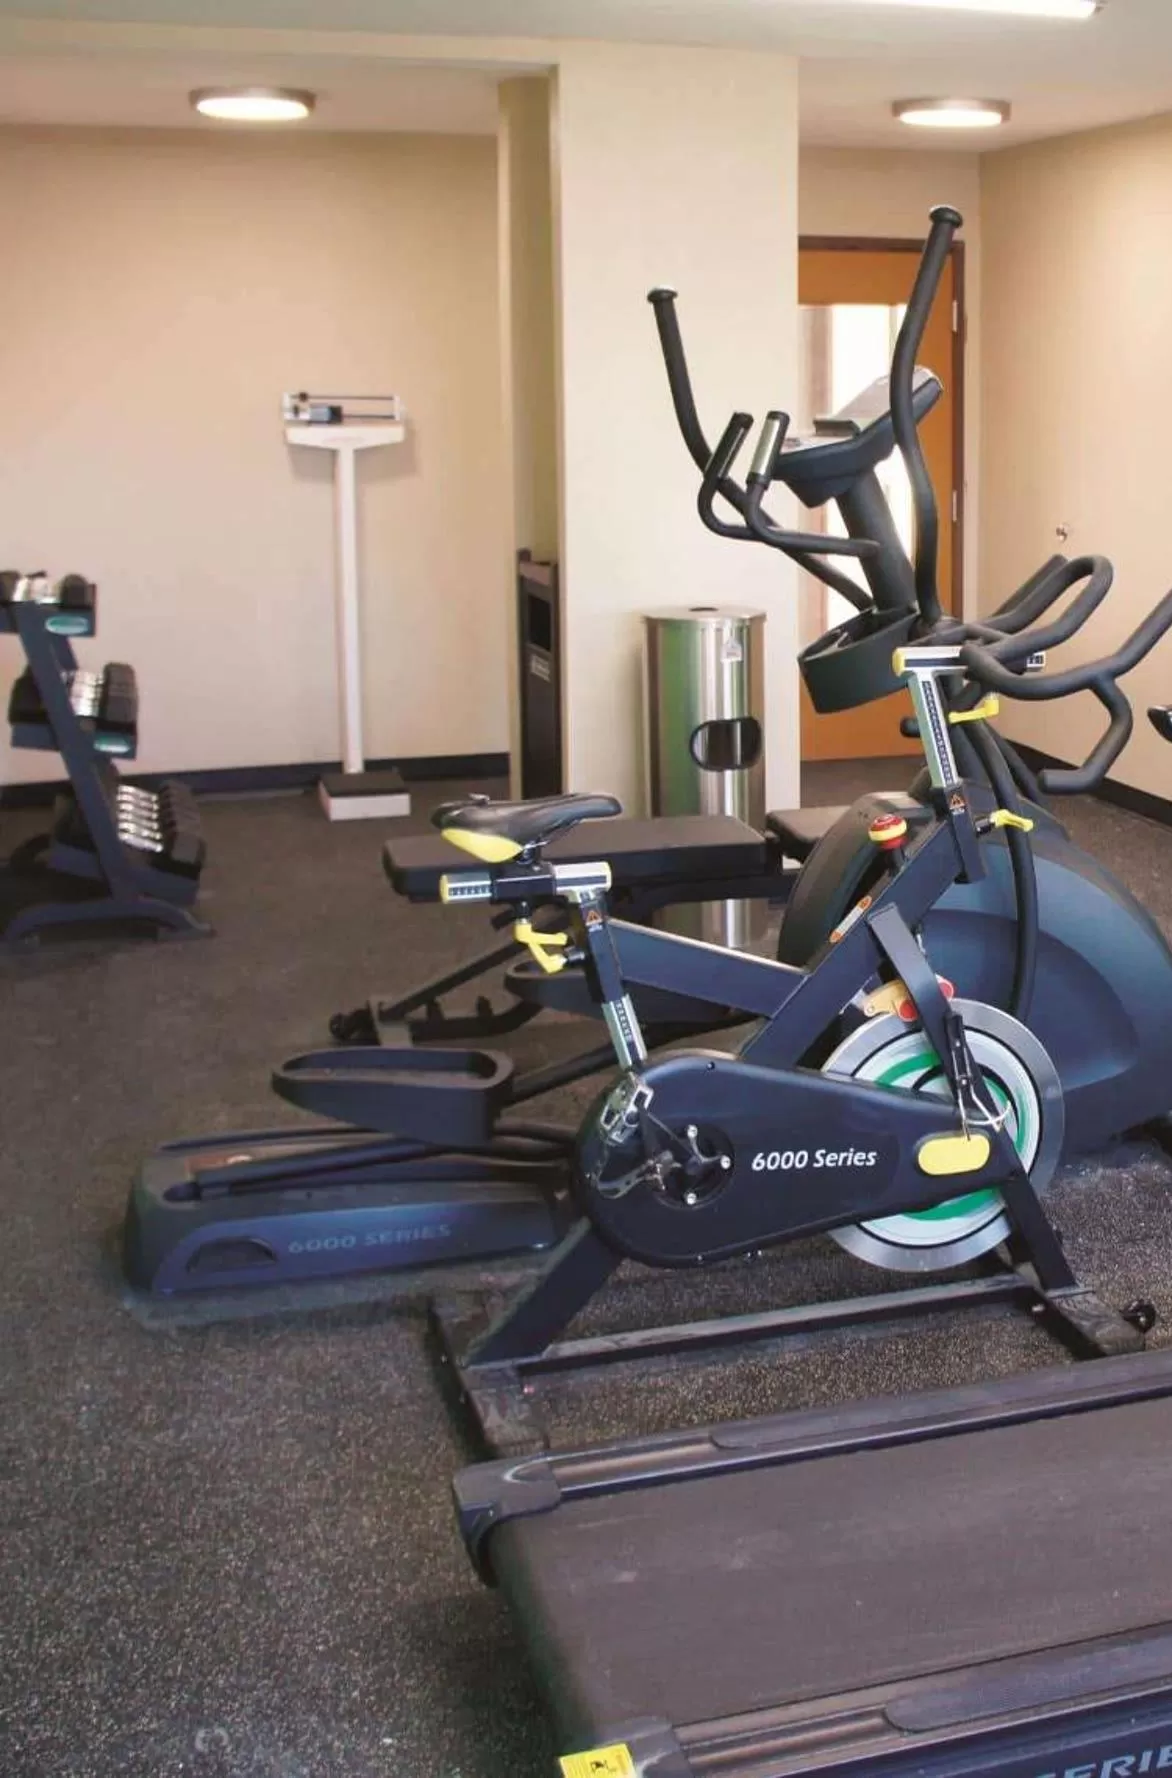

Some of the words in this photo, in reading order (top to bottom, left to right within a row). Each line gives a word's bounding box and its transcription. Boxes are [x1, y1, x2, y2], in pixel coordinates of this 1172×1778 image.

[751, 1149, 809, 1171] 6000
[812, 1147, 878, 1168] Series
[288, 1235, 357, 1253] 6000
[363, 1223, 452, 1247] SERIES
